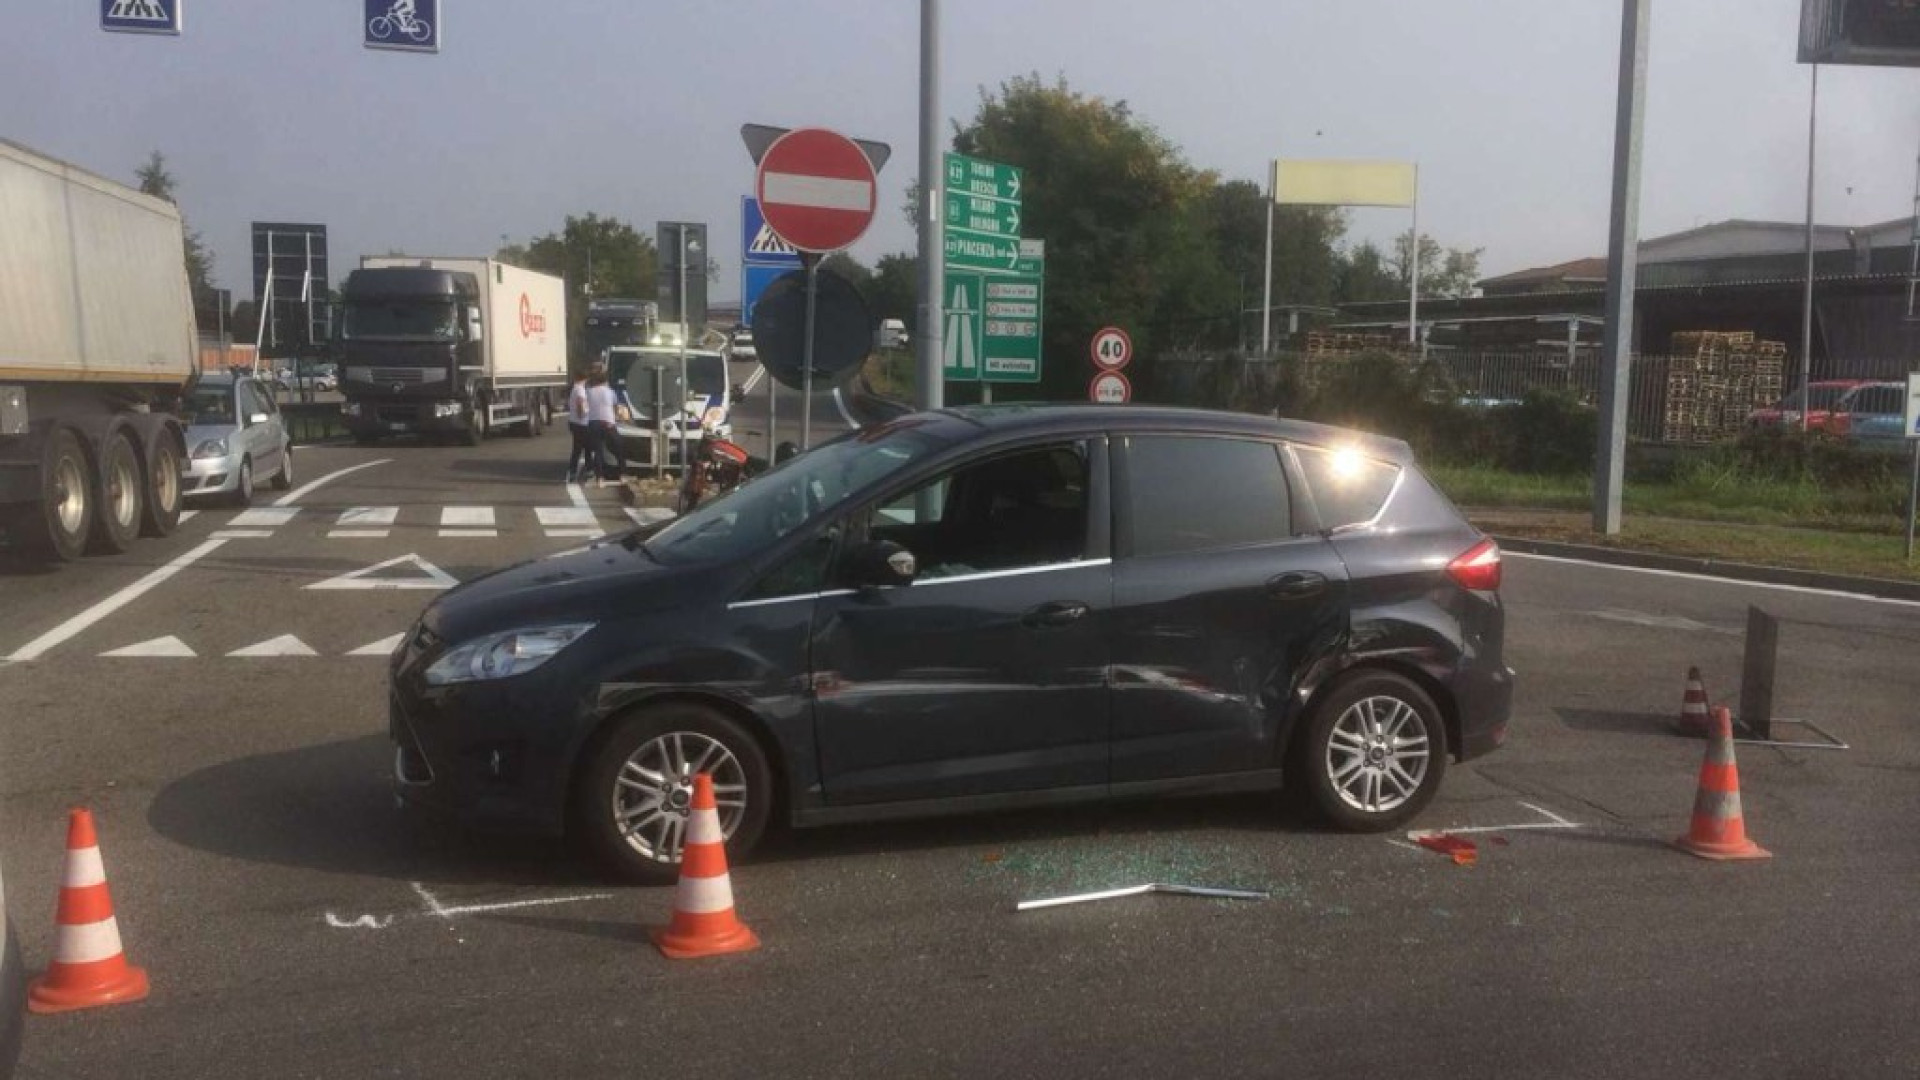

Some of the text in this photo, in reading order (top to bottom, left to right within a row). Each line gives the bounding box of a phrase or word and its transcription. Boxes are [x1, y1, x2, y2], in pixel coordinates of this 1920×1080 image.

[970, 162, 995, 178] TORINO
[970, 180, 998, 196] BRESCIA
[957, 240, 994, 257] PIACENZA
[1101, 340, 1122, 358] 40
